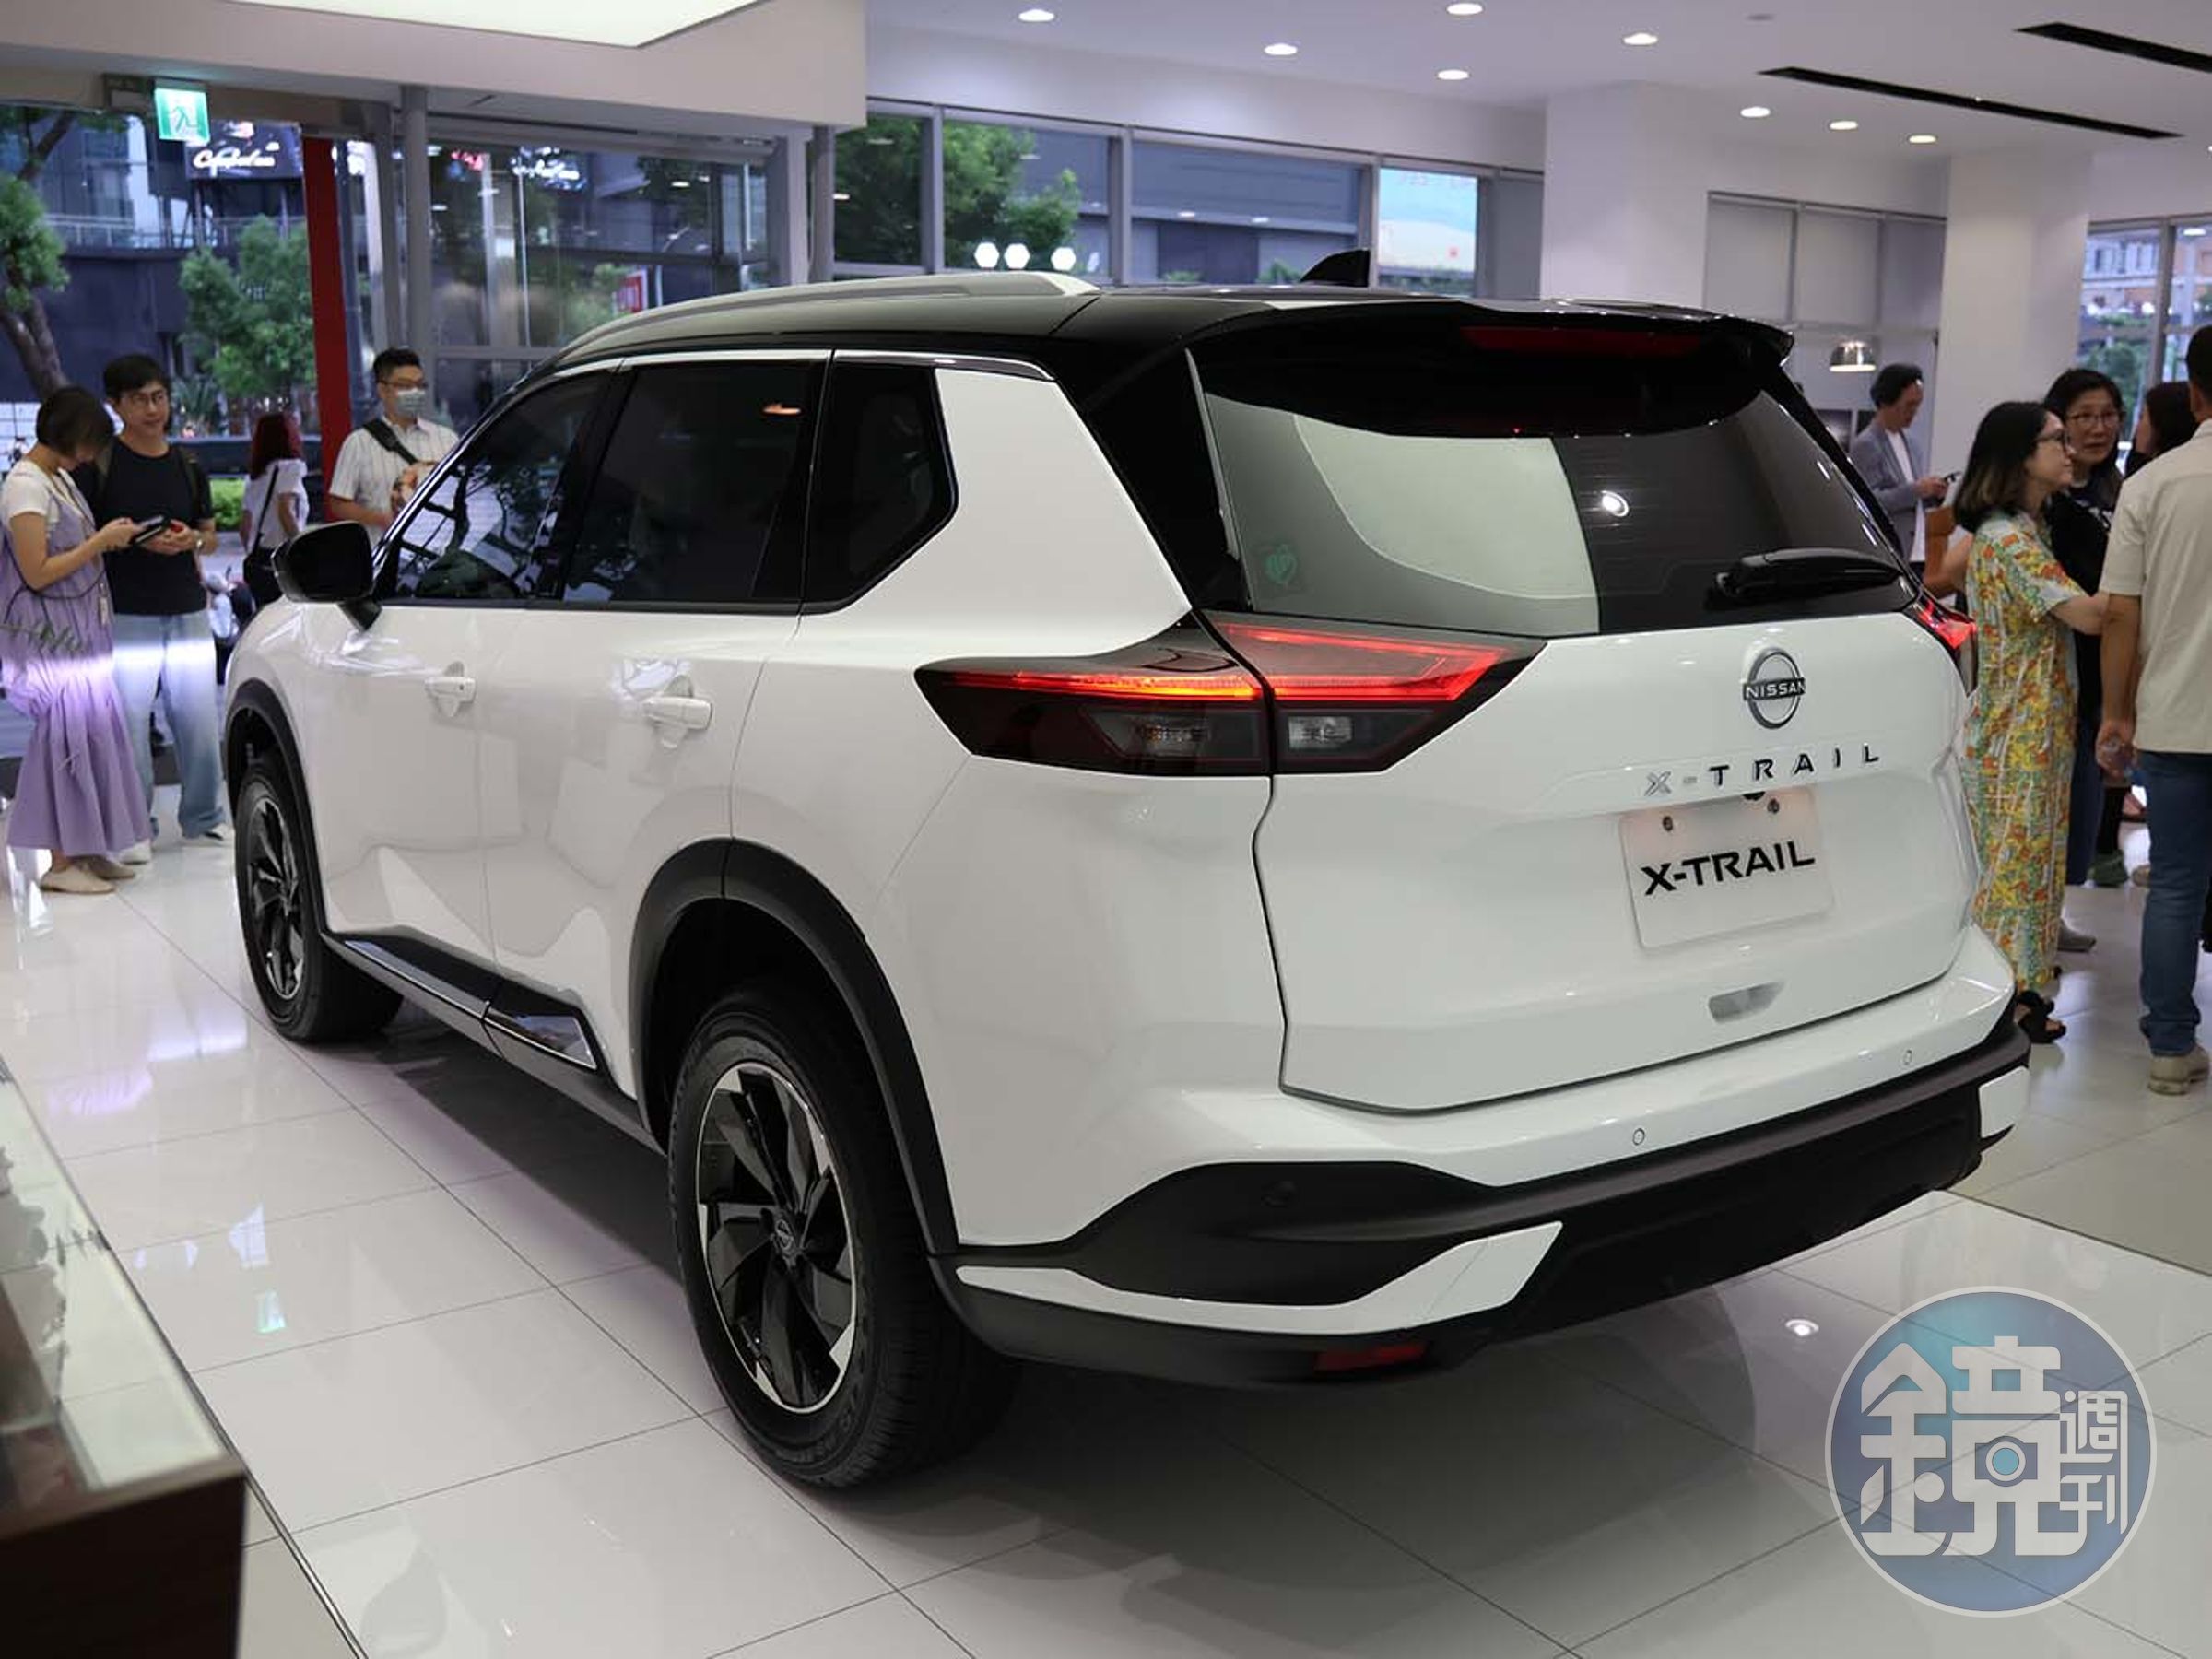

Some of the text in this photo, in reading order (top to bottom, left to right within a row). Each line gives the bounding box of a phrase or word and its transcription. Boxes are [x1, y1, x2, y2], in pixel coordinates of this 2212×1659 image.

[1746, 681, 1806, 699] NISSAN
[1644, 745, 1878, 796] X-TRAIL
[1641, 841, 1815, 896] X-TRAIL
